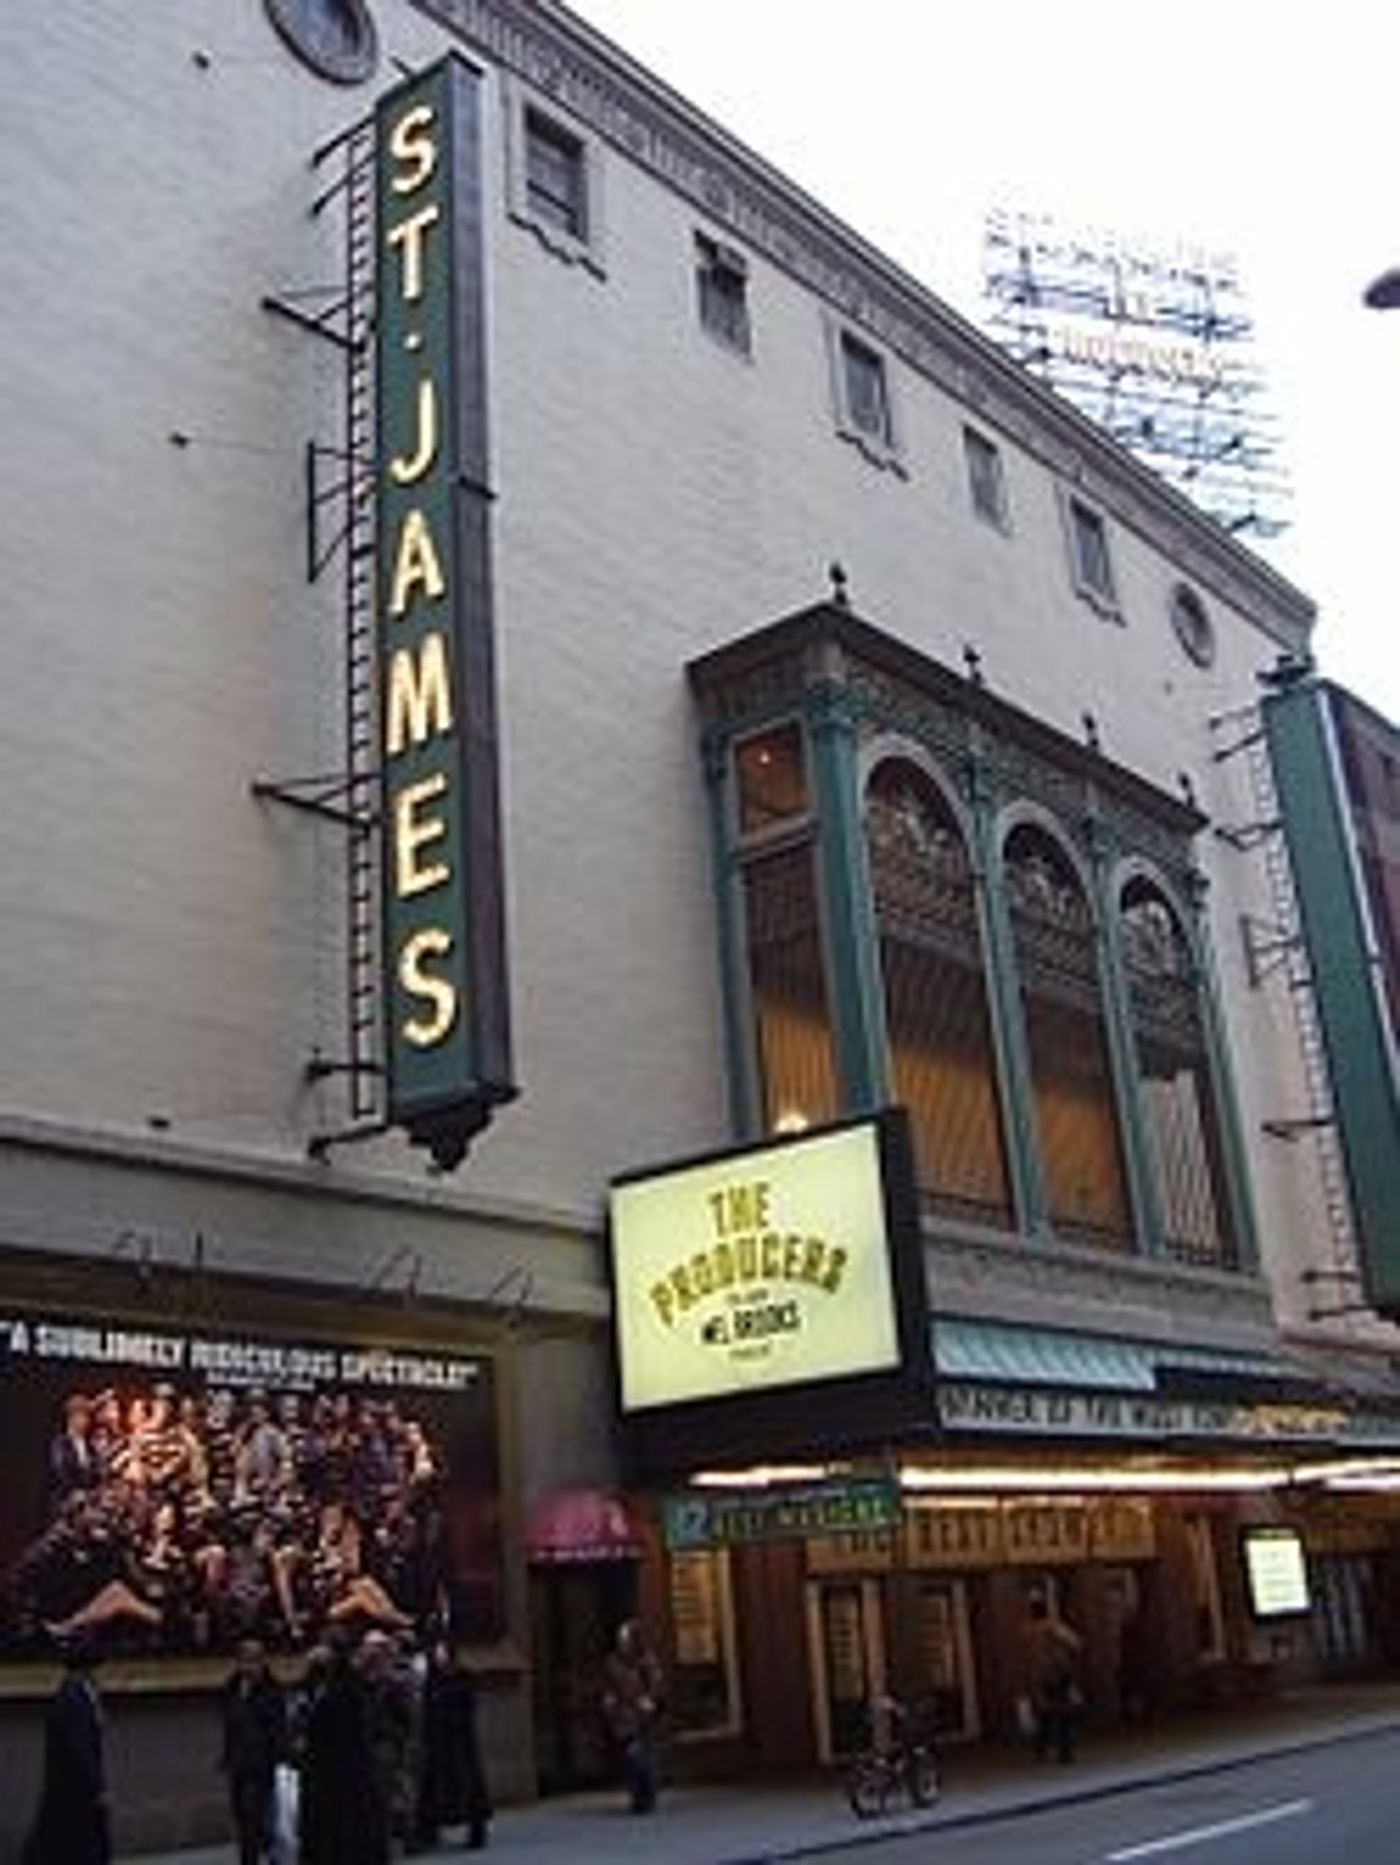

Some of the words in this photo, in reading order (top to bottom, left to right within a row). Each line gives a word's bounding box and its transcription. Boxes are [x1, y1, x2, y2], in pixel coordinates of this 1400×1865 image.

[387, 379, 458, 1046] JAMES
[709, 1182, 771, 1238] THE
[650, 1232, 847, 1327] PRODUCERS
